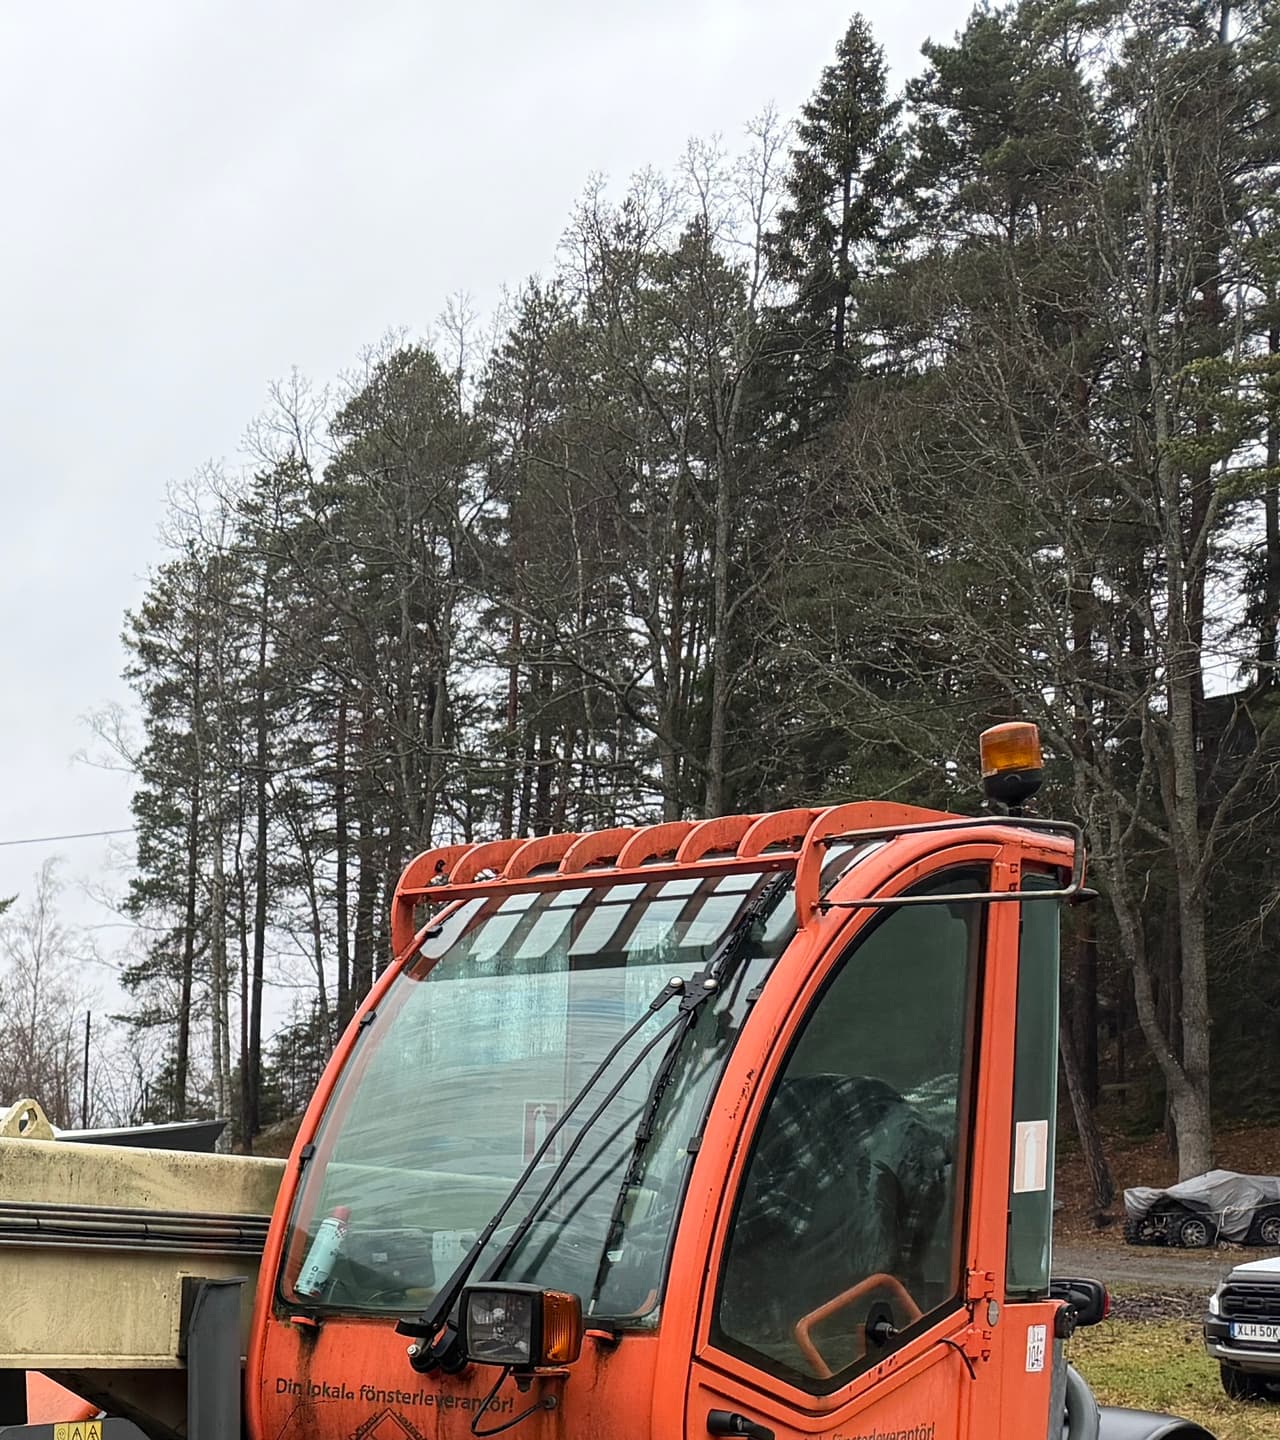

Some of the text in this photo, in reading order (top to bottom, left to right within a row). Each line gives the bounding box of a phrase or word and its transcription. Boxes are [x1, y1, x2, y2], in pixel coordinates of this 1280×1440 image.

[1238, 1324, 1257, 1337] XLH
[276, 1377, 302, 1396] Din
[307, 1379, 355, 1400] lokala
